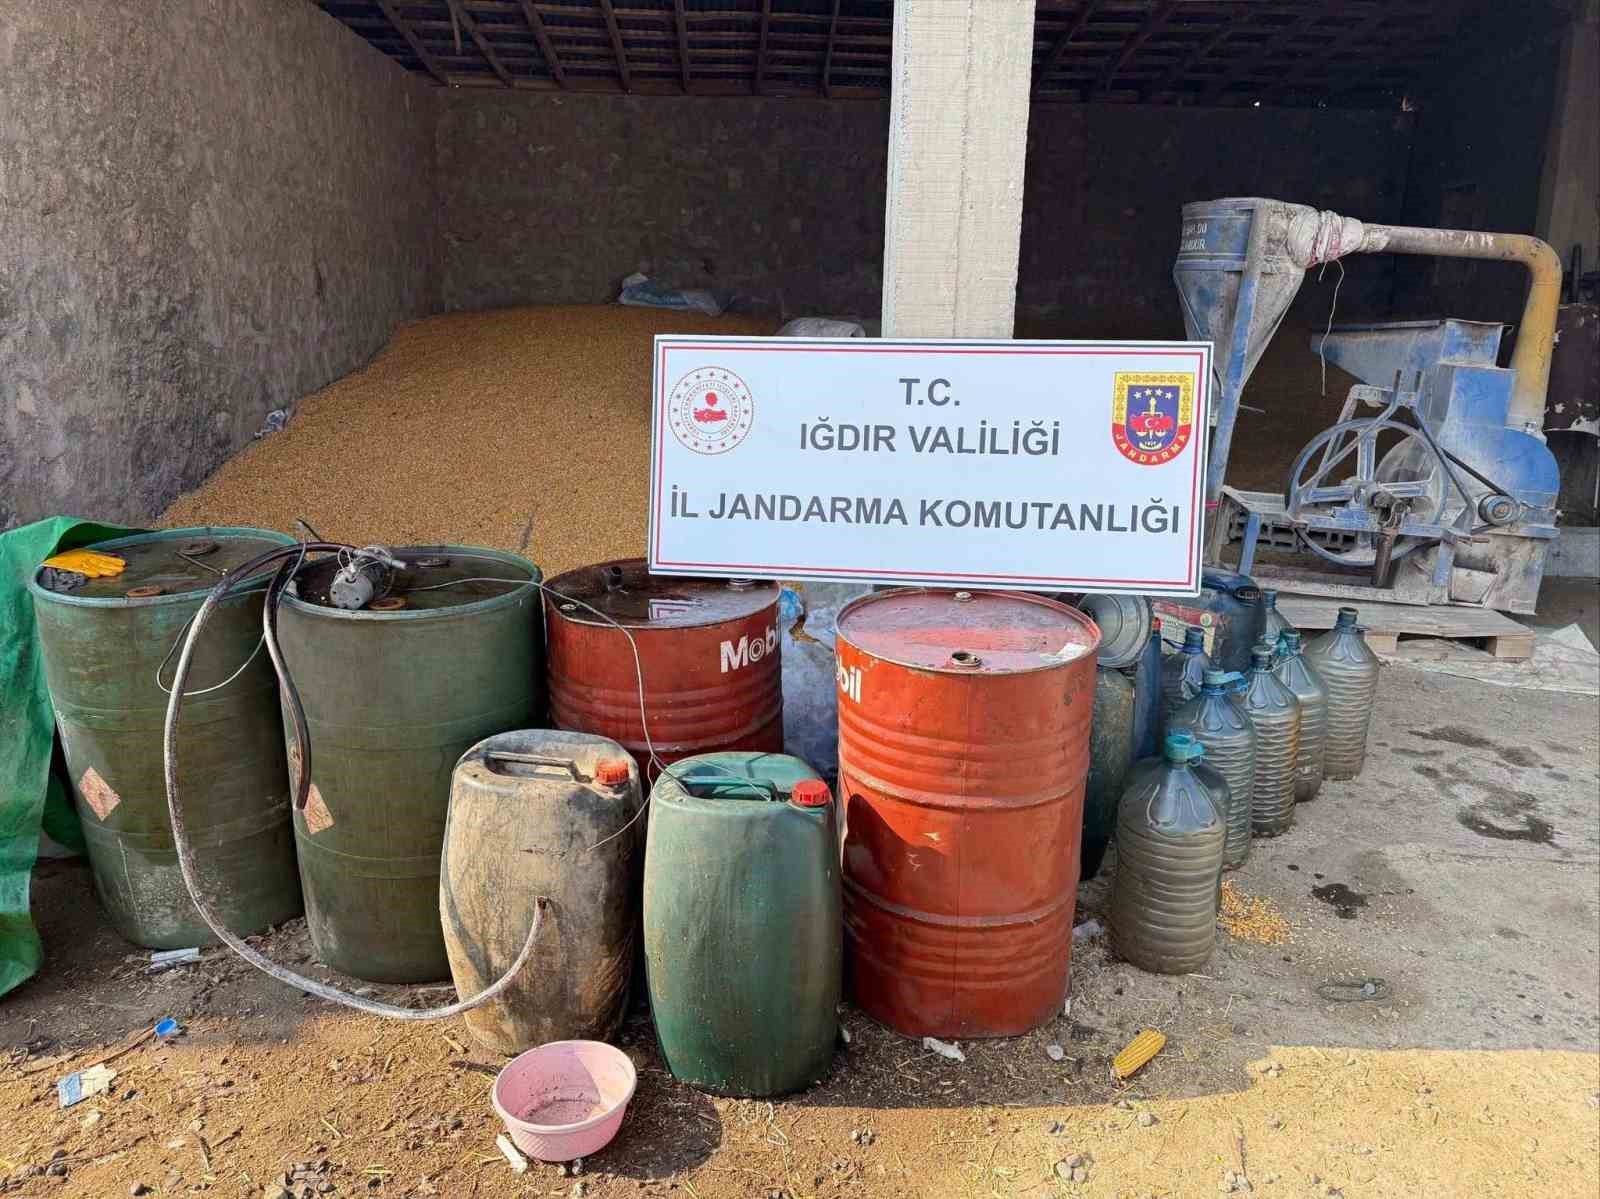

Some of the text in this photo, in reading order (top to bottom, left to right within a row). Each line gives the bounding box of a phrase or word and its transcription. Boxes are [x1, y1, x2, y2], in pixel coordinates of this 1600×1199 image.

[899, 378, 960, 406] T.C.
[800, 416, 1060, 456] IĞDIR VALİLİĞİ
[1115, 432, 1187, 462] JANDARMA
[671, 484, 1179, 534] İL JANDARMA KOMUTANLIĞI
